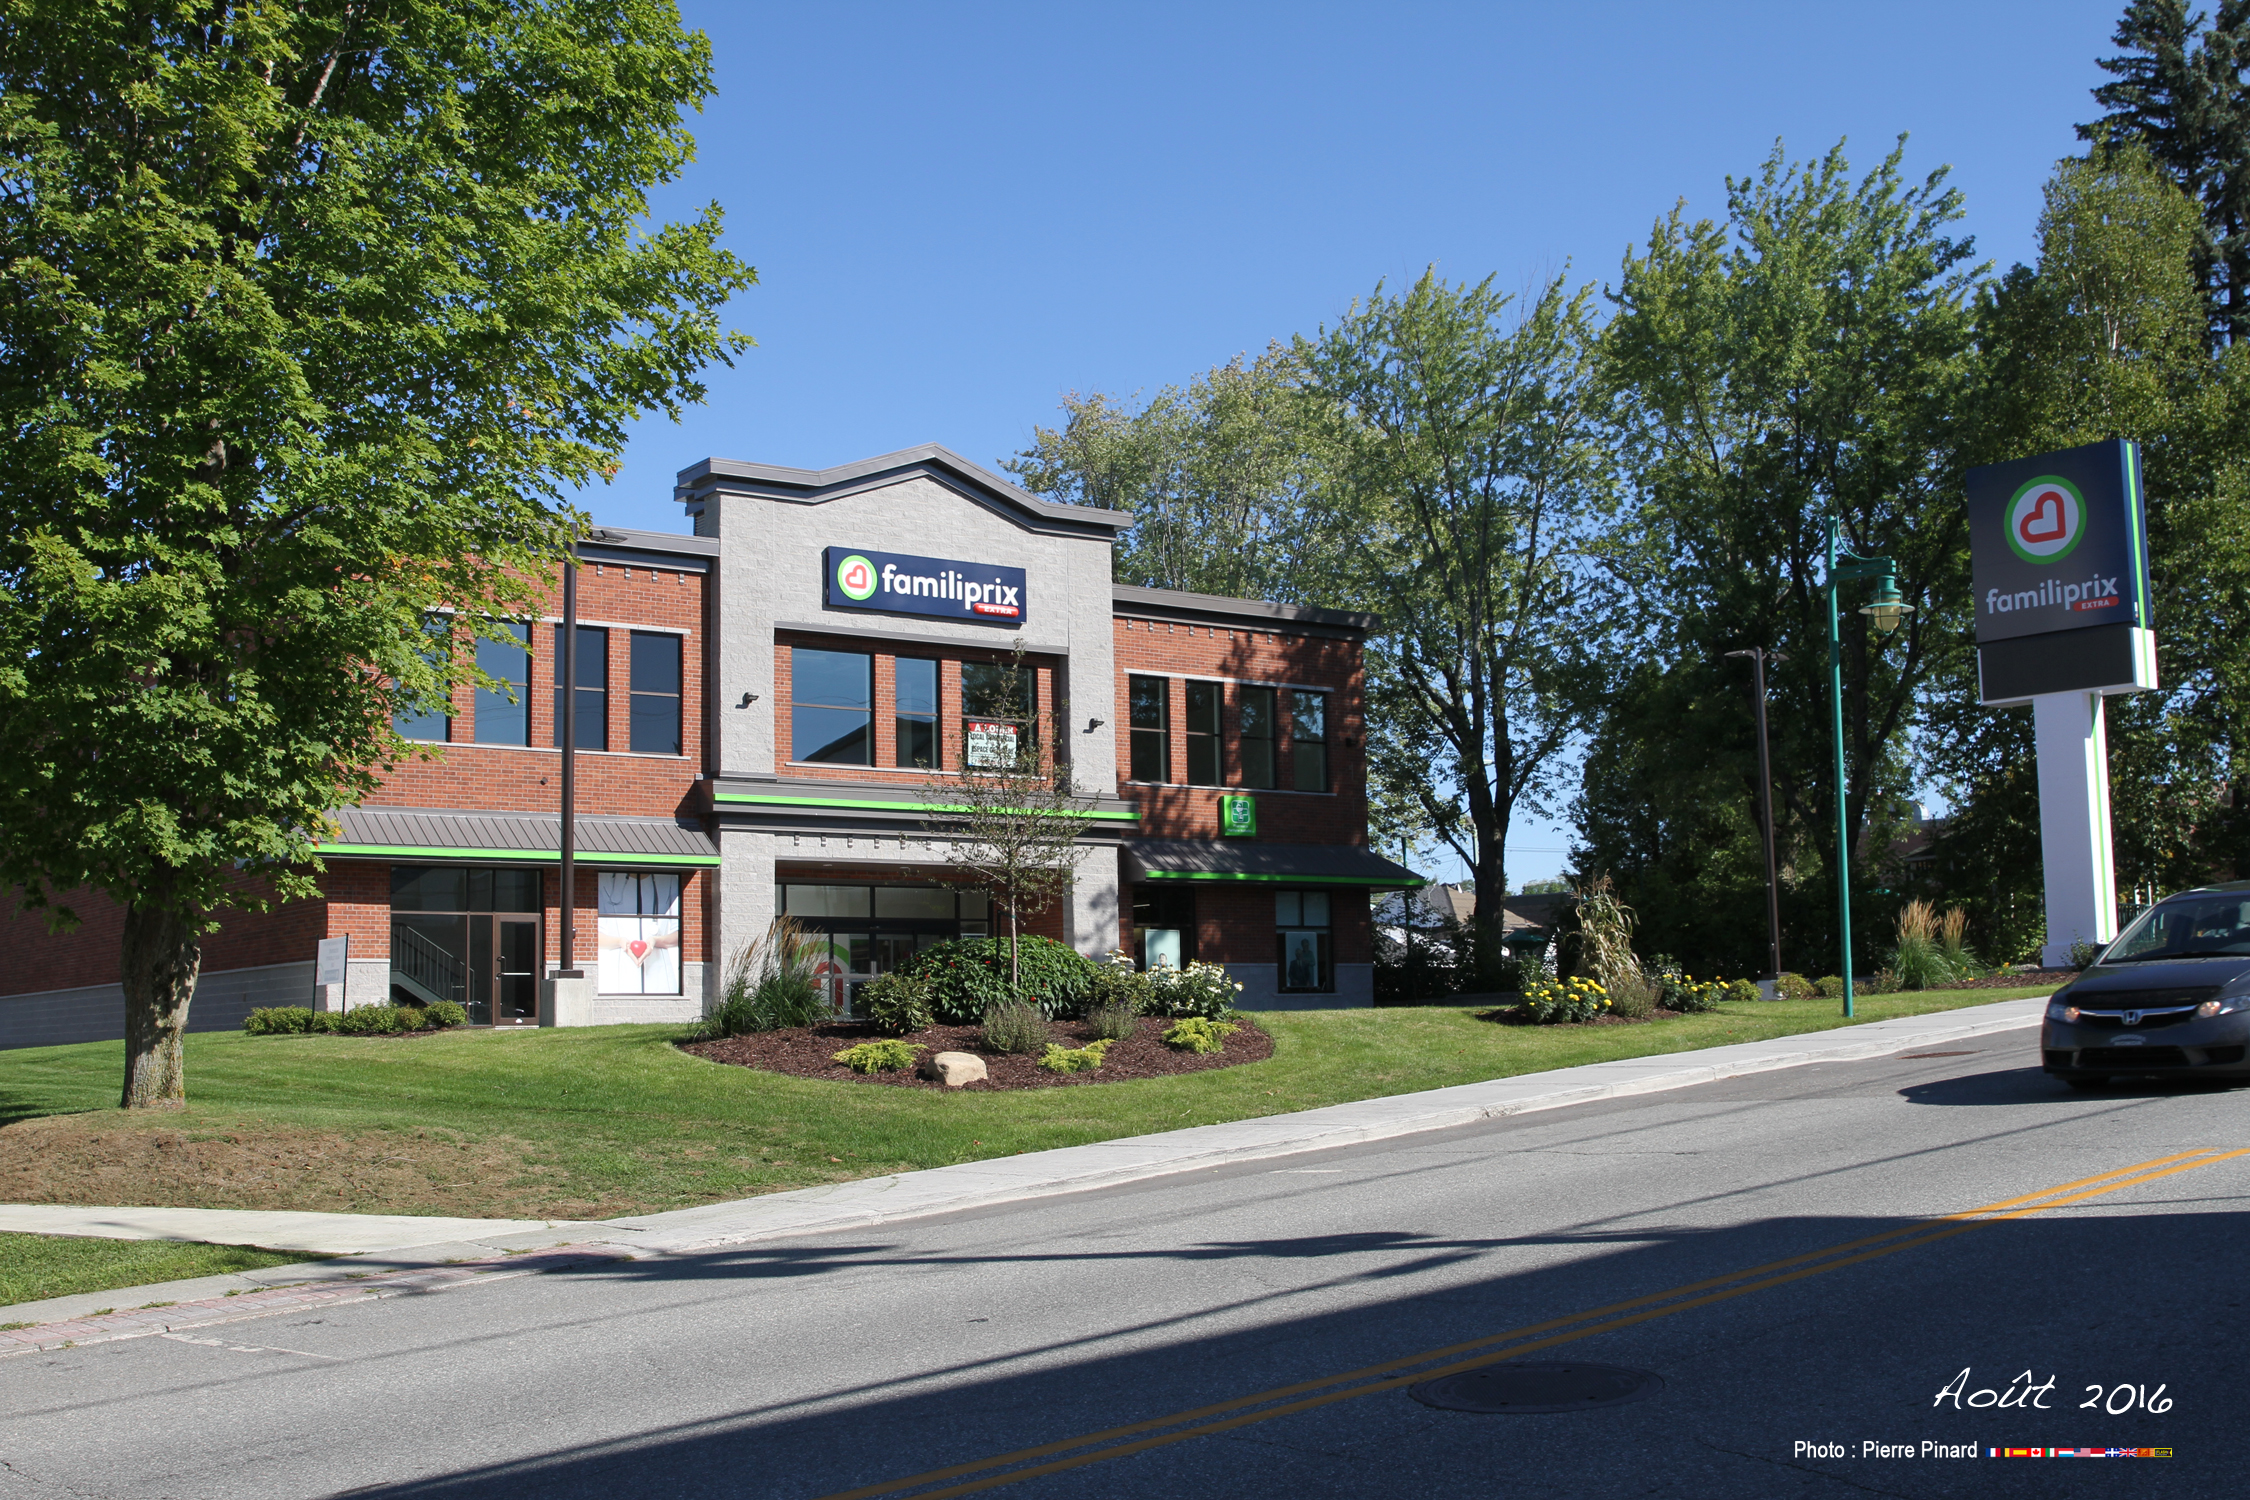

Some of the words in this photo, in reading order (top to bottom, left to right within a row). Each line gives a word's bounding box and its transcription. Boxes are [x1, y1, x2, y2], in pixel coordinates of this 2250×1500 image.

[881, 563, 1019, 610] familiprix
[1985, 573, 2119, 614] familiprix
[984, 605, 1012, 615] EXTRA
[2081, 599, 2110, 610] EXTRA
